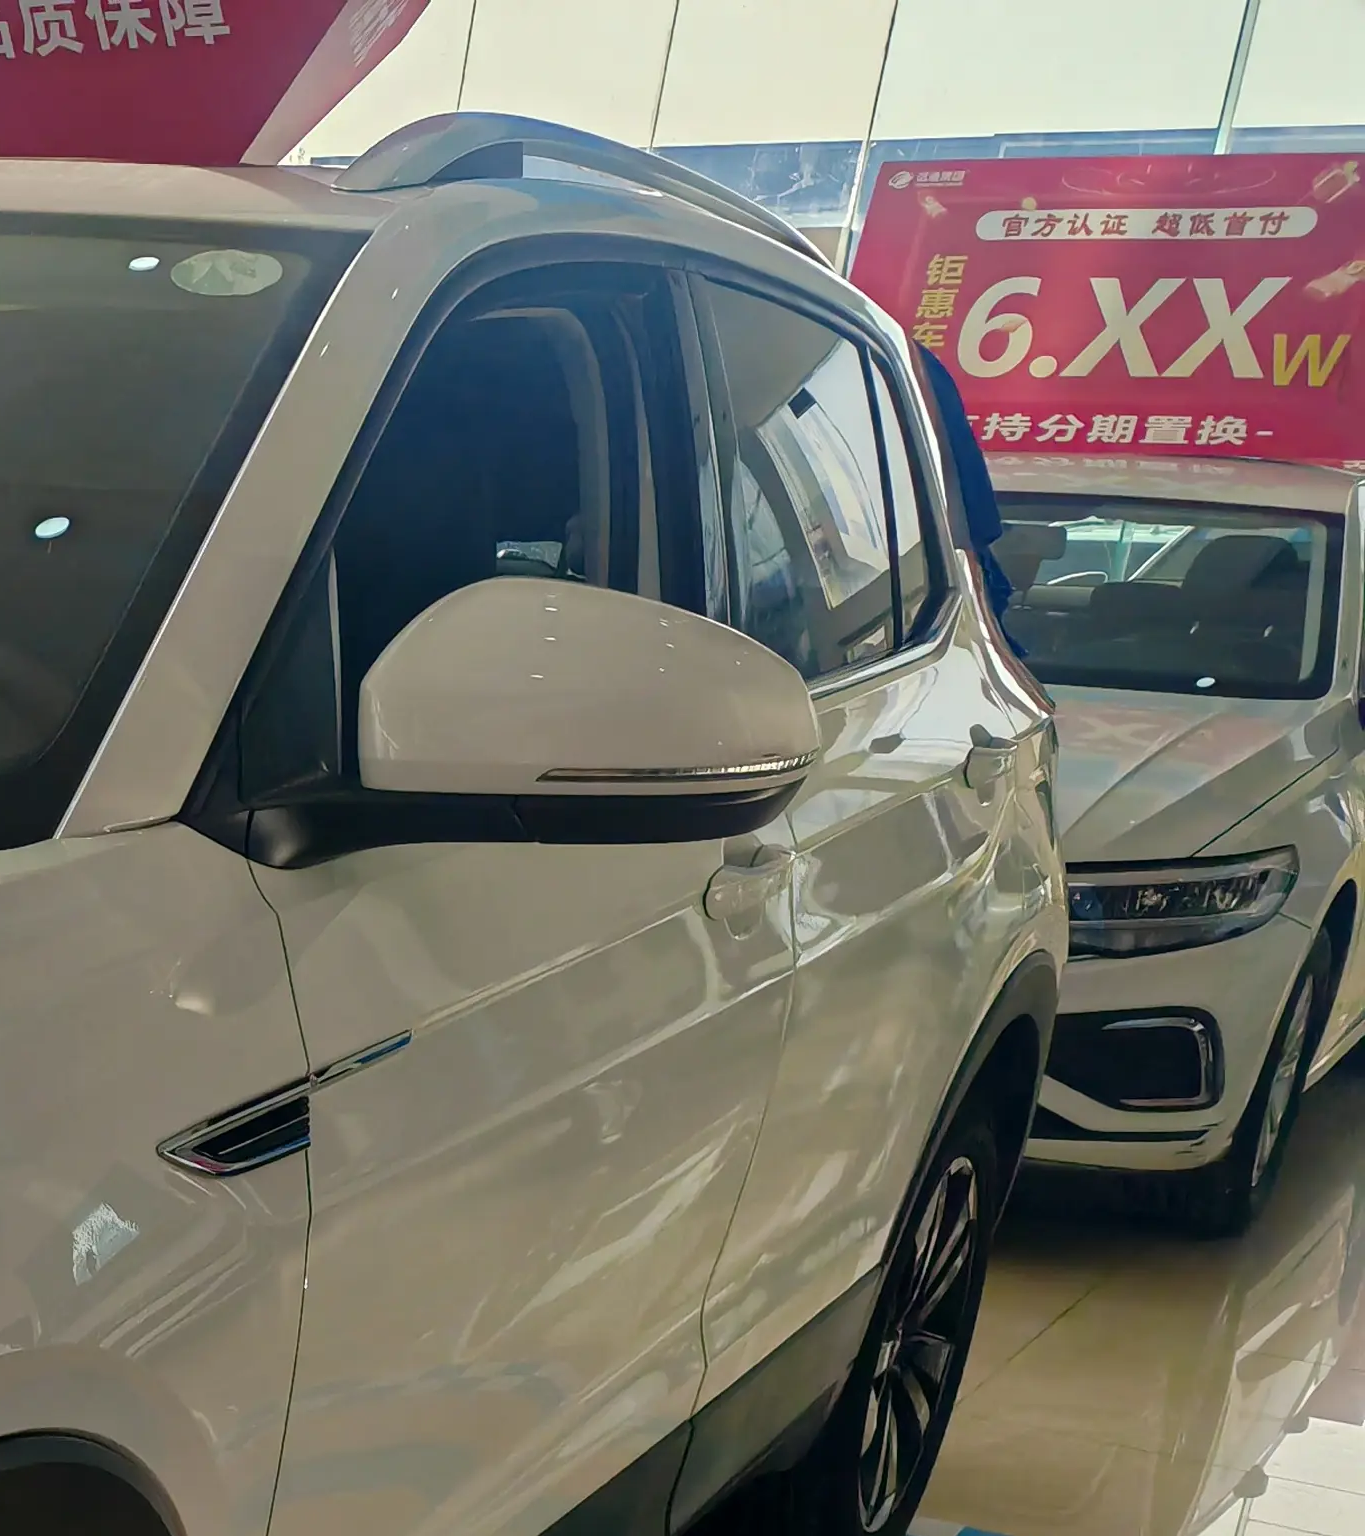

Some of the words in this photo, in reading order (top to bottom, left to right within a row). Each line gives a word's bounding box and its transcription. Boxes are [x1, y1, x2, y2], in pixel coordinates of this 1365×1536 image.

[1002, 212, 1129, 238] 官方认证
[1151, 211, 1289, 238] 超低首付
